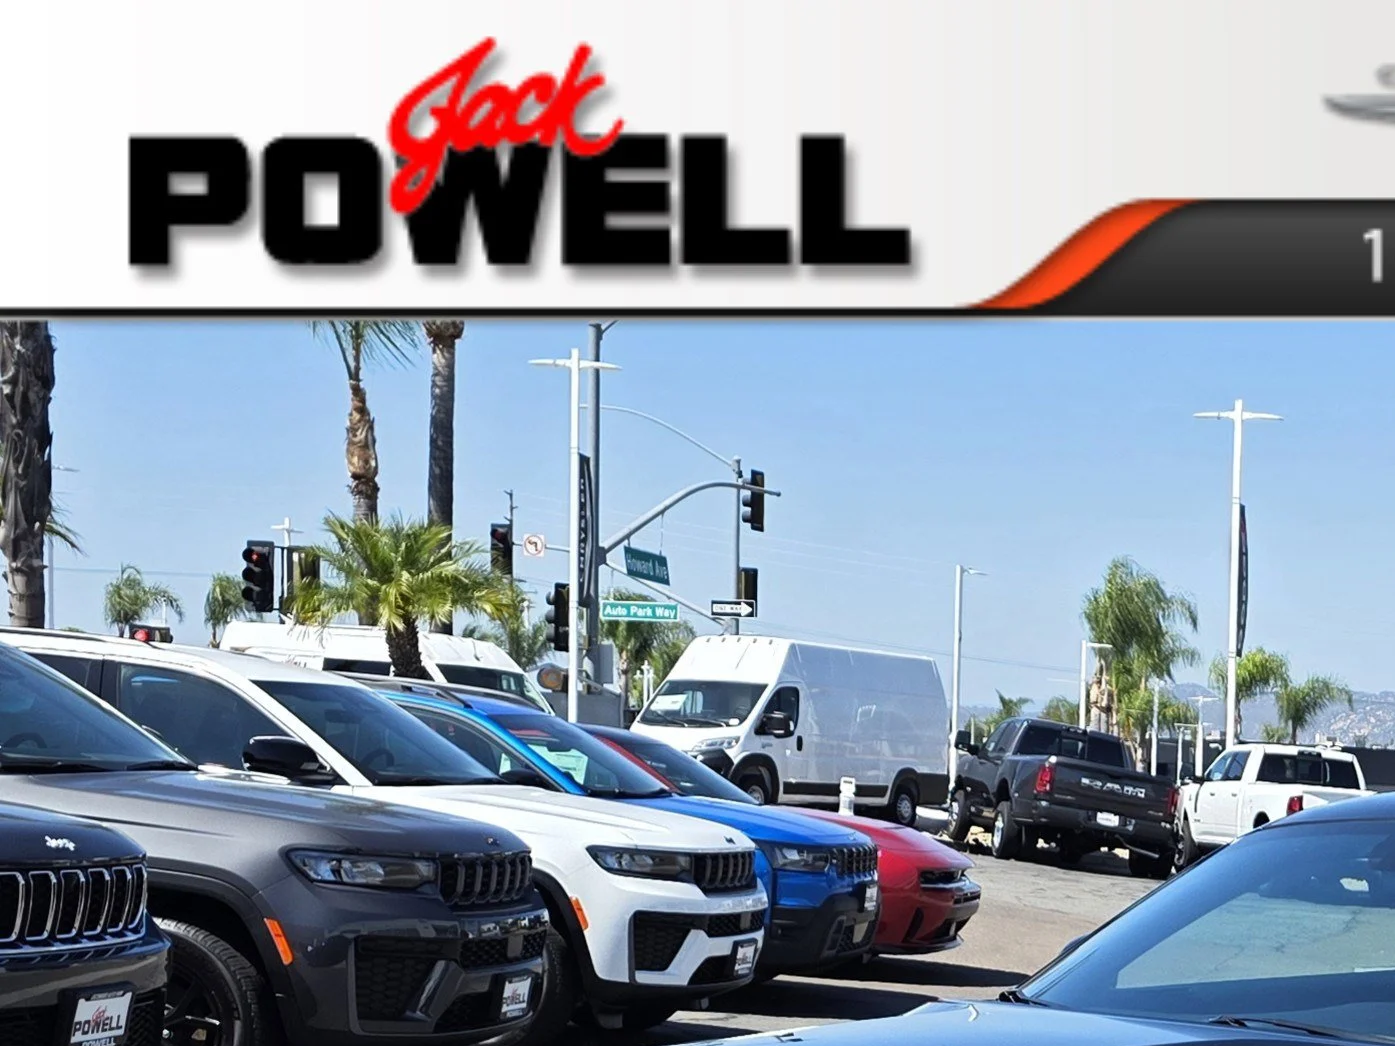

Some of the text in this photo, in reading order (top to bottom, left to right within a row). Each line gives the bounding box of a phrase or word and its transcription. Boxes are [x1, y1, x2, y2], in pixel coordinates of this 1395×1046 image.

[626, 554, 669, 580] Howard Ave
[604, 605, 677, 618] Auto Park Way
[72, 1014, 123, 1037] POWELL
